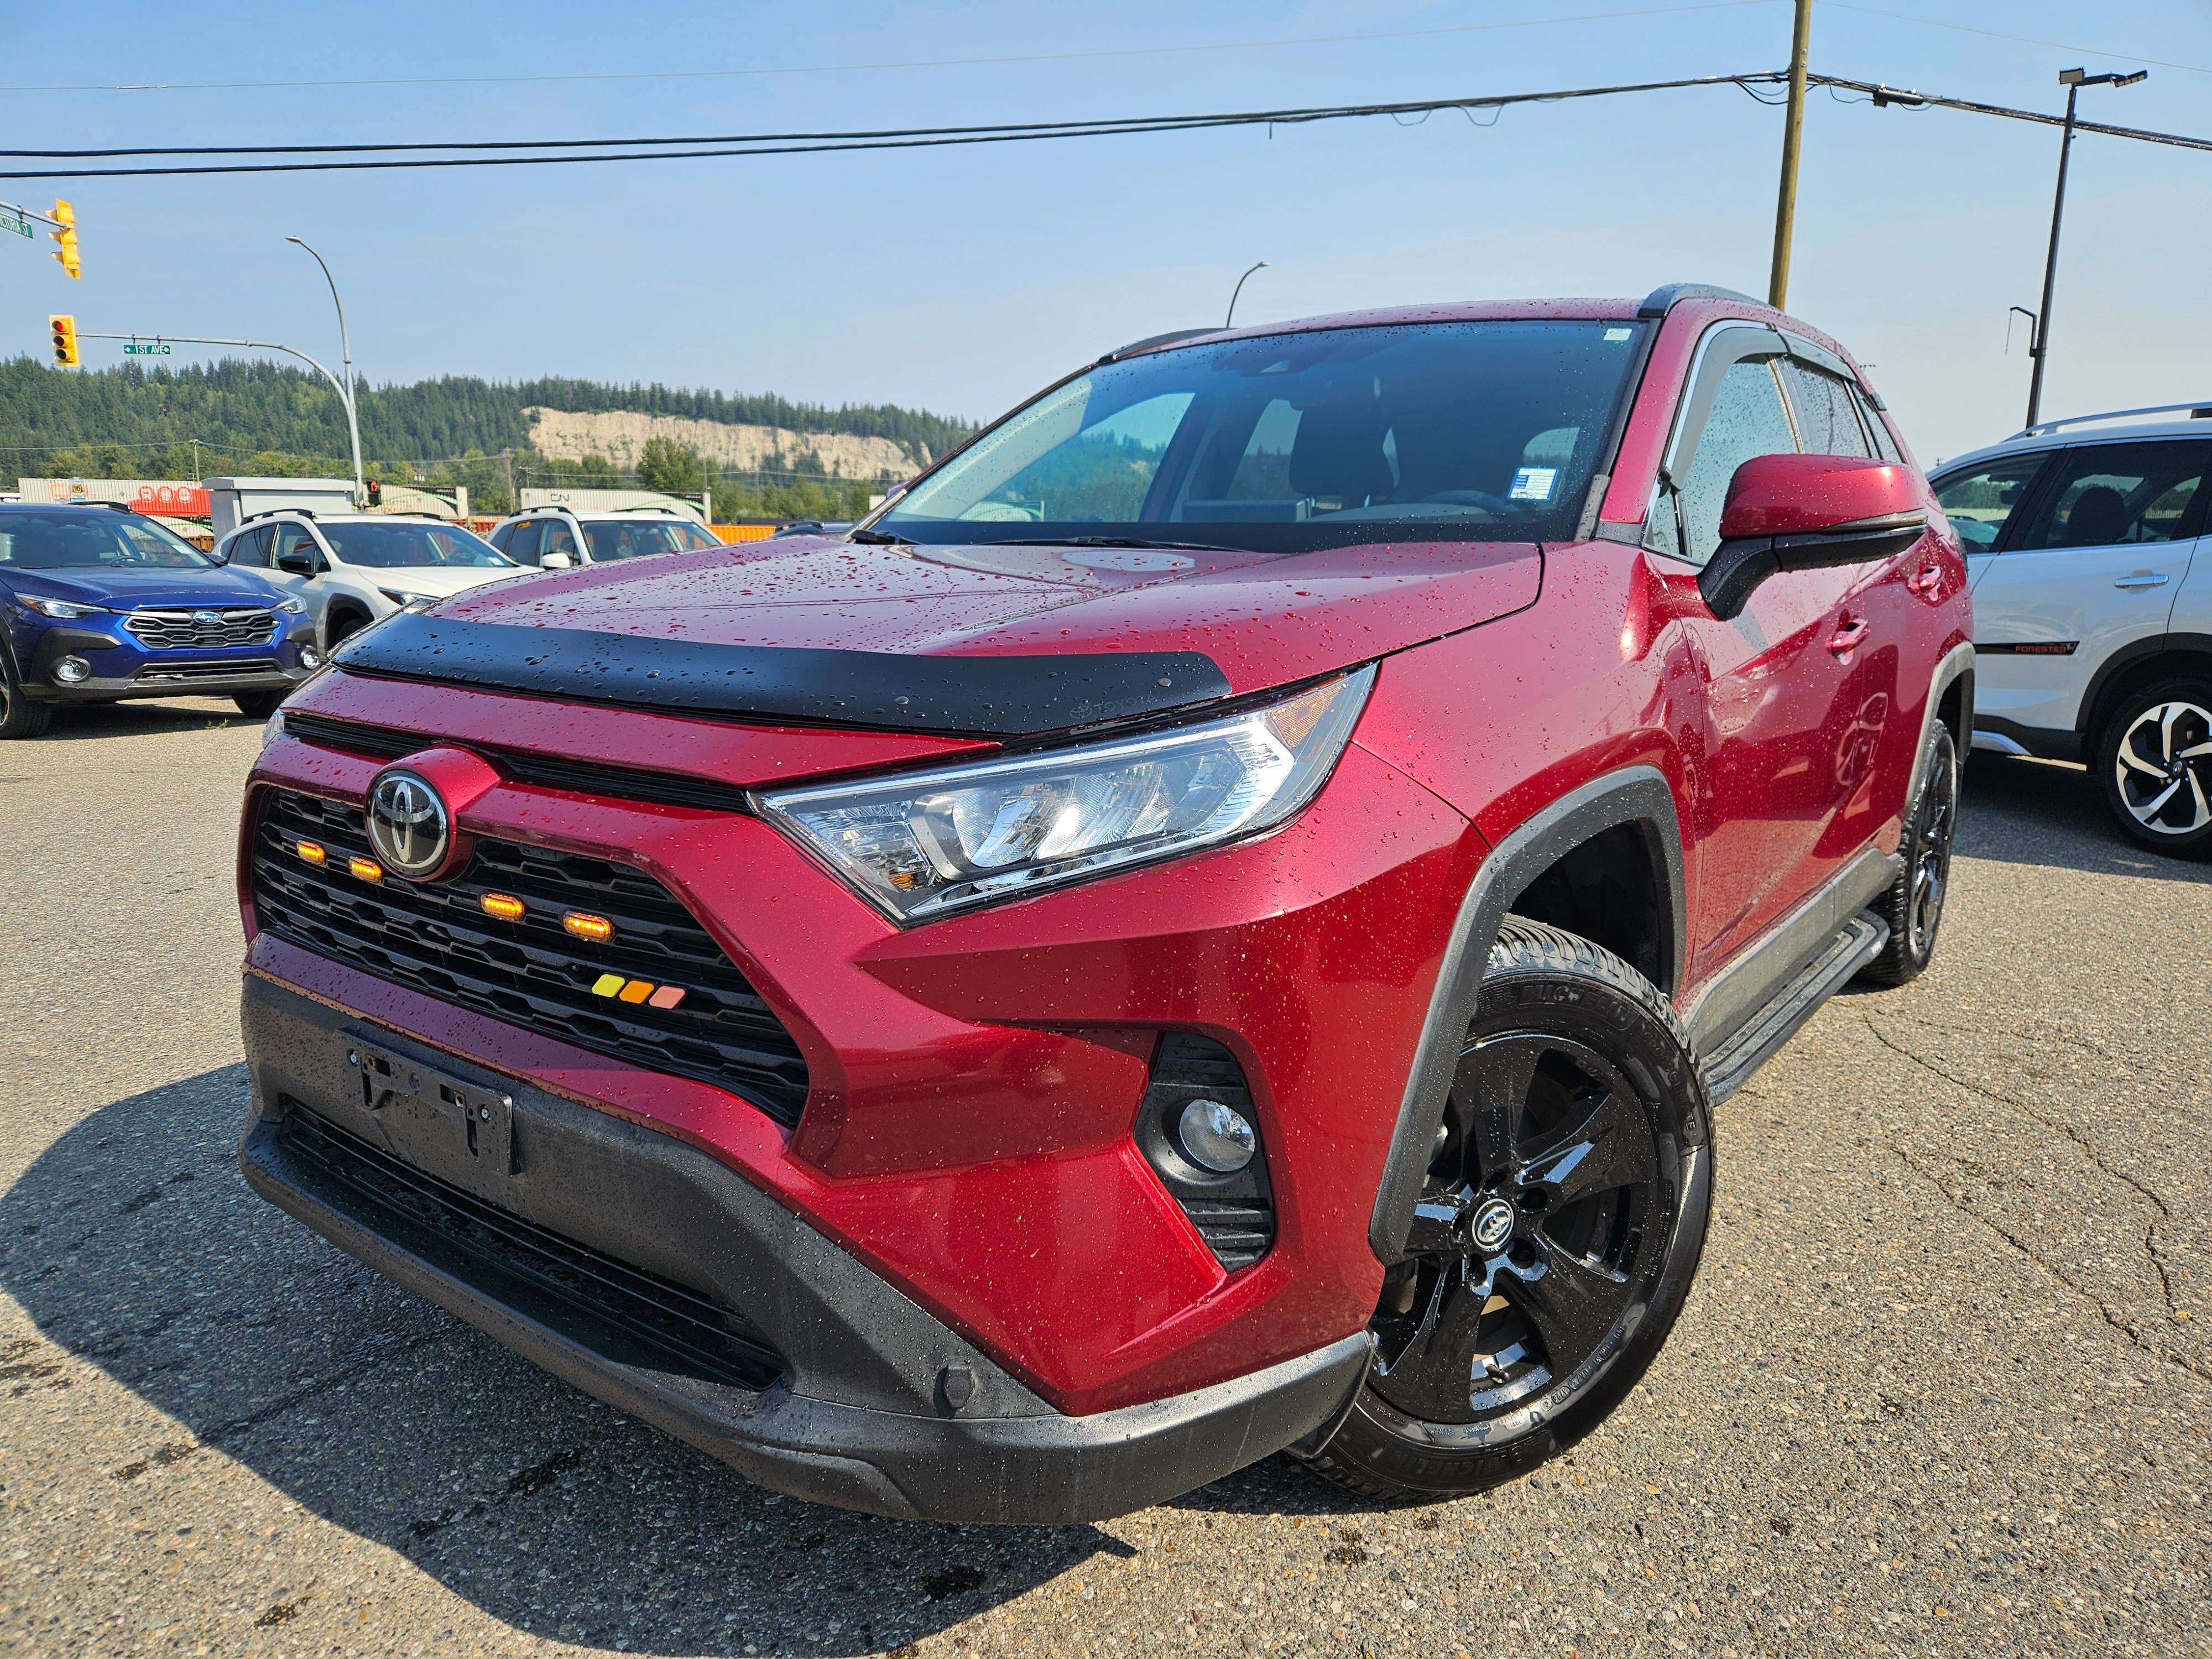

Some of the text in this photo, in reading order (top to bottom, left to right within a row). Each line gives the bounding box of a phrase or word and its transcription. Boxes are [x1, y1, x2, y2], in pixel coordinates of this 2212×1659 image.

[22, 223, 28, 237] ST
[135, 346, 165, 354] 1ST AVE
[1094, 693, 1156, 712] TOYOTA
